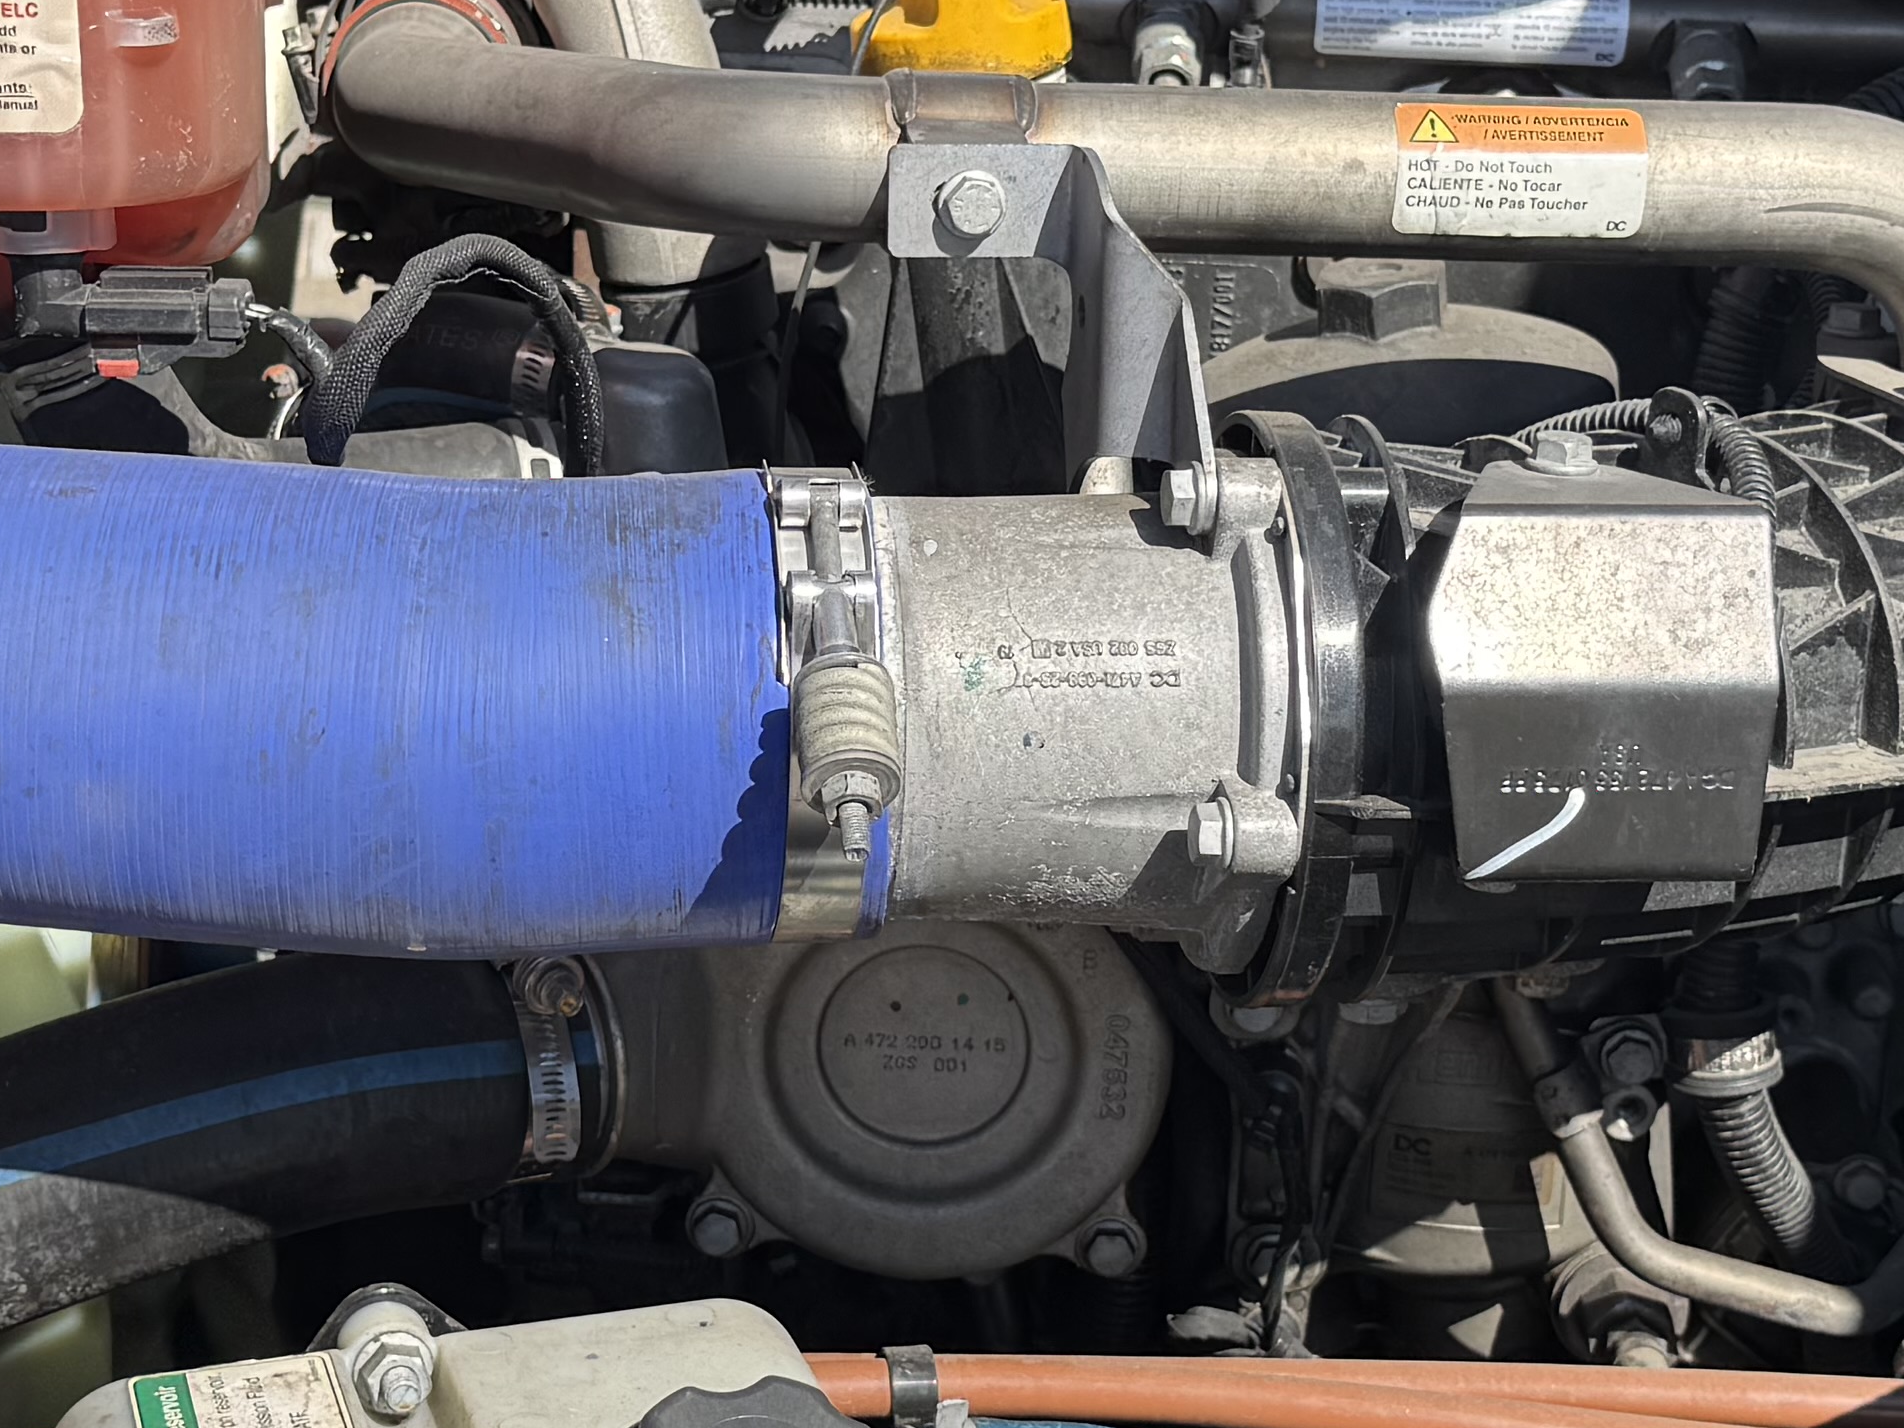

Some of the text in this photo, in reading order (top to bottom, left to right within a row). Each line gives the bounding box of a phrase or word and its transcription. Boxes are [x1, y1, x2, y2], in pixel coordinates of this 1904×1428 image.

[0, 2, 39, 19] ELC
[20, 45, 38, 56] or
[1455, 113, 1630, 128] WARNING ADVERTENCIA
[1491, 129, 1605, 143] AVERTISSEMENT
[1408, 158, 1553, 174] HOT Do Not Touch
[1407, 176, 1563, 192] CALIENTE No Tocar
[1405, 194, 1461, 209] CHAUD
[1498, 197, 1526, 210] Pas
[1529, 198, 1589, 211] Toucher
[1606, 220, 1627, 232] DC
[843, 1033, 1006, 1053] A 472 200 14 15
[881, 1054, 968, 1073] ZGS 001
[1394, 1133, 1432, 1156] DC
